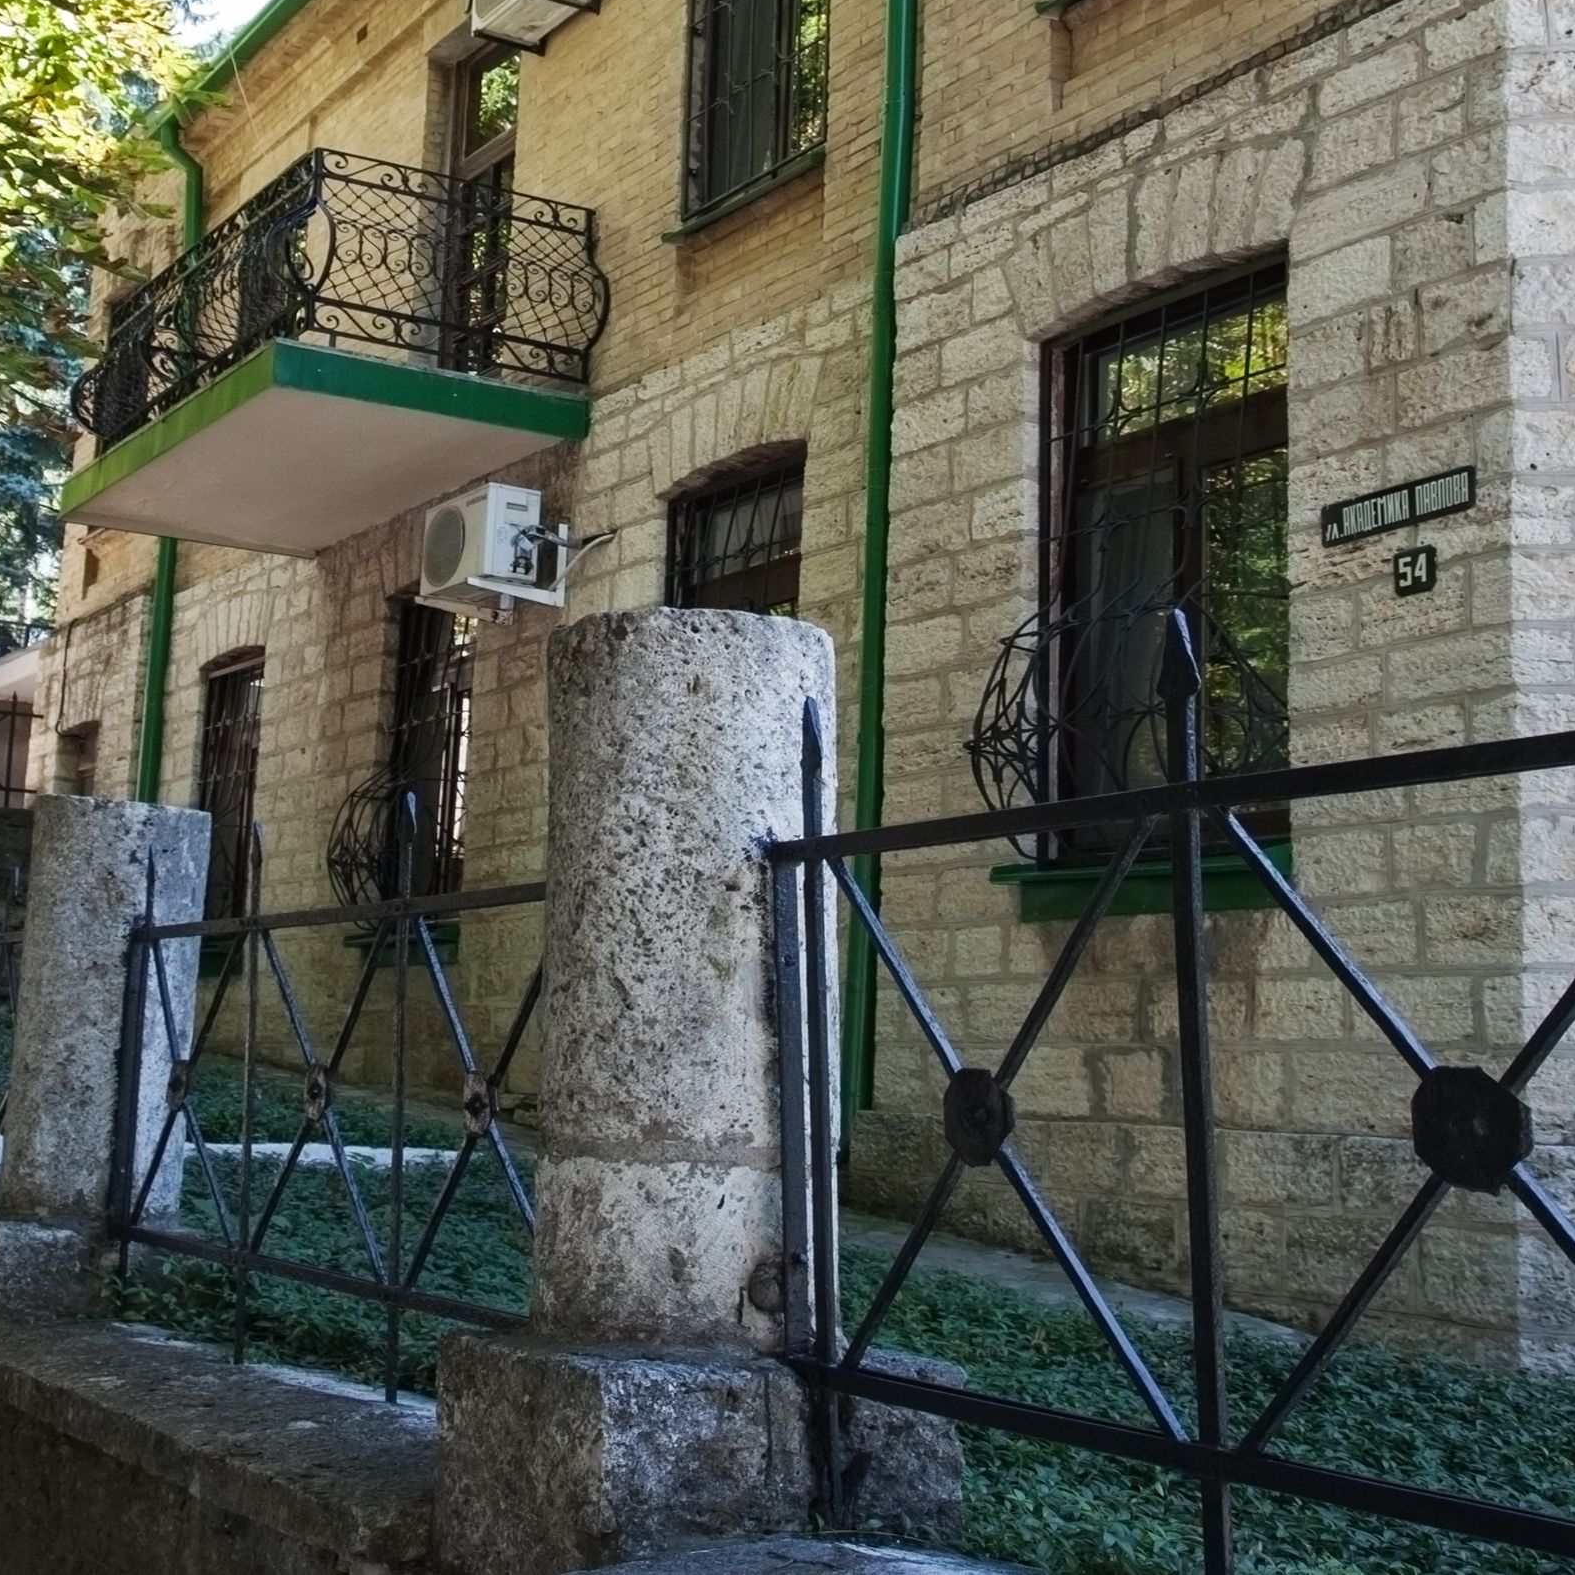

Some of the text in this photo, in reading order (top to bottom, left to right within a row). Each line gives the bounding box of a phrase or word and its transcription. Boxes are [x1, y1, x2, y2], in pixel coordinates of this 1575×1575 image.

[1342, 489, 1410, 537] АКАДЕМИКА
[1415, 471, 1469, 516] ПАВЛОВА
[1398, 553, 1427, 587] 54
